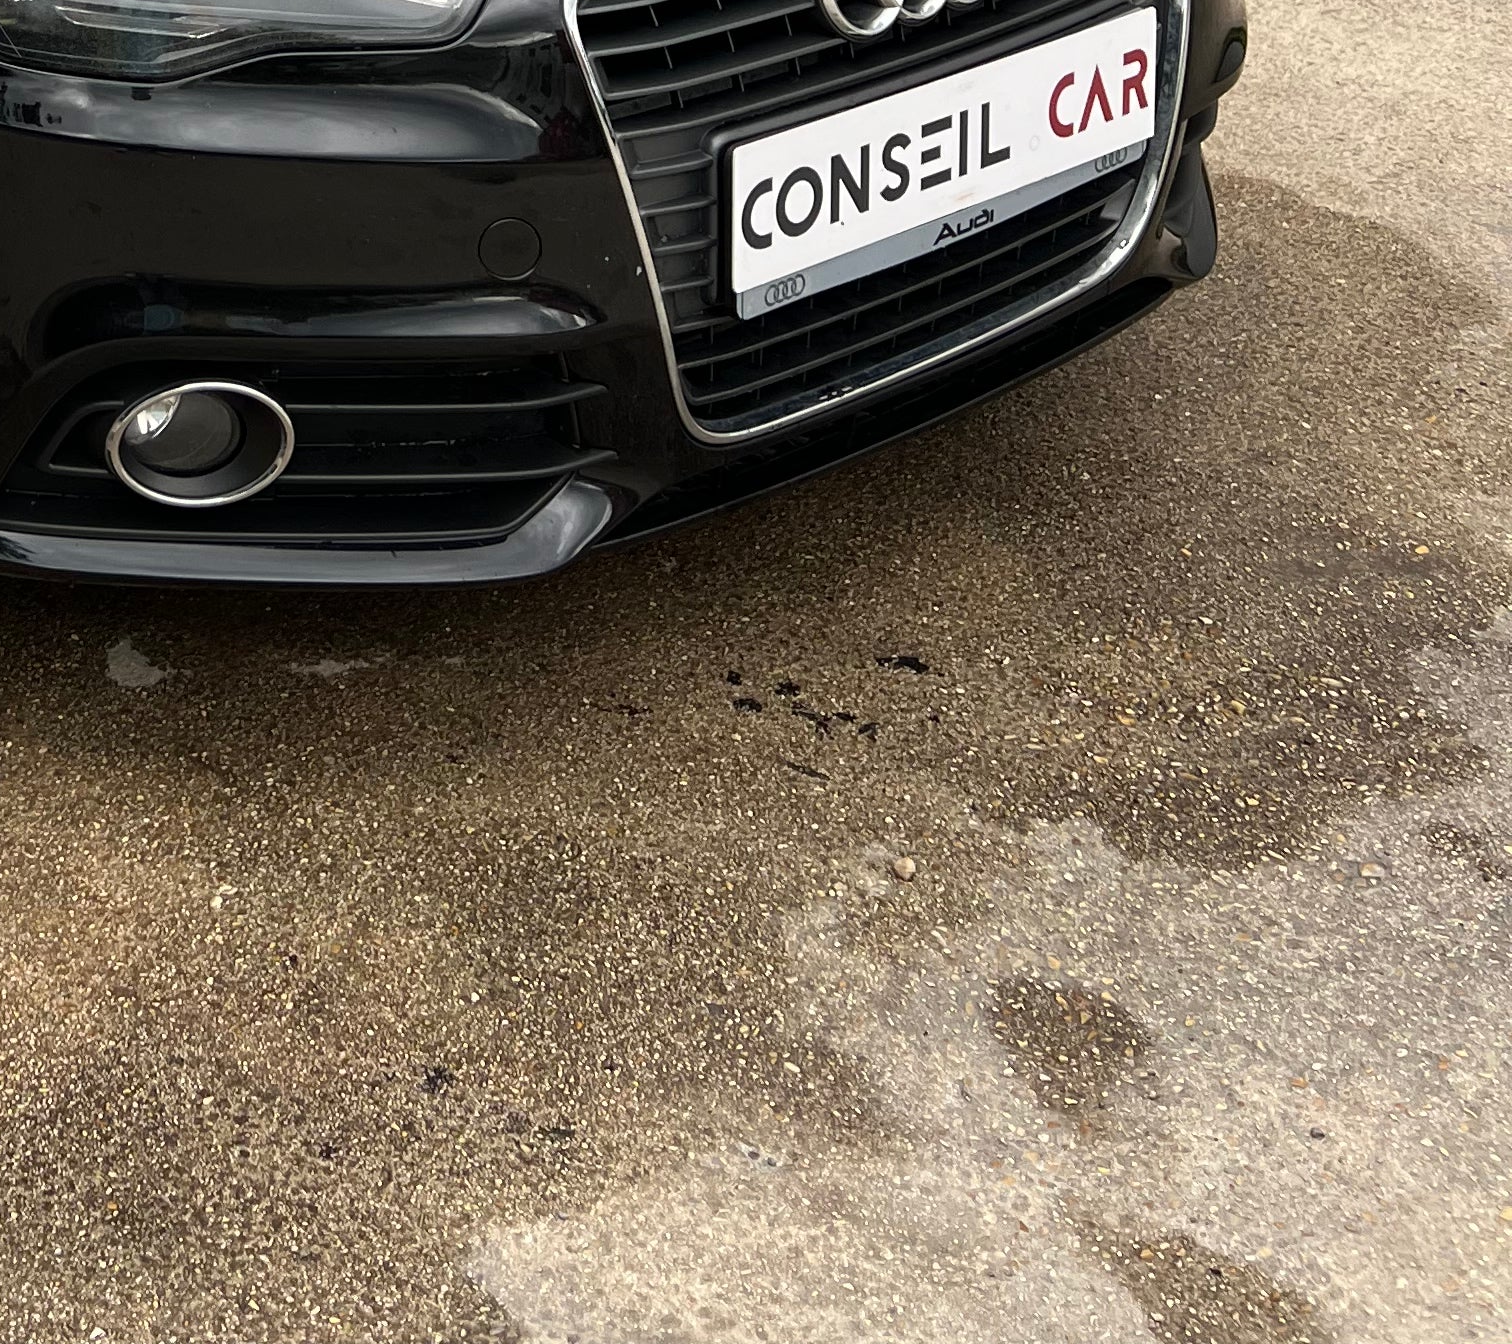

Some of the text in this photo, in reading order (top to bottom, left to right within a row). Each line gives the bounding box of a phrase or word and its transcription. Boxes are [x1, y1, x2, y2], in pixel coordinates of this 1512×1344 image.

[742, 48, 1150, 250] CONSEIL CAR
[933, 208, 995, 246] Audi
